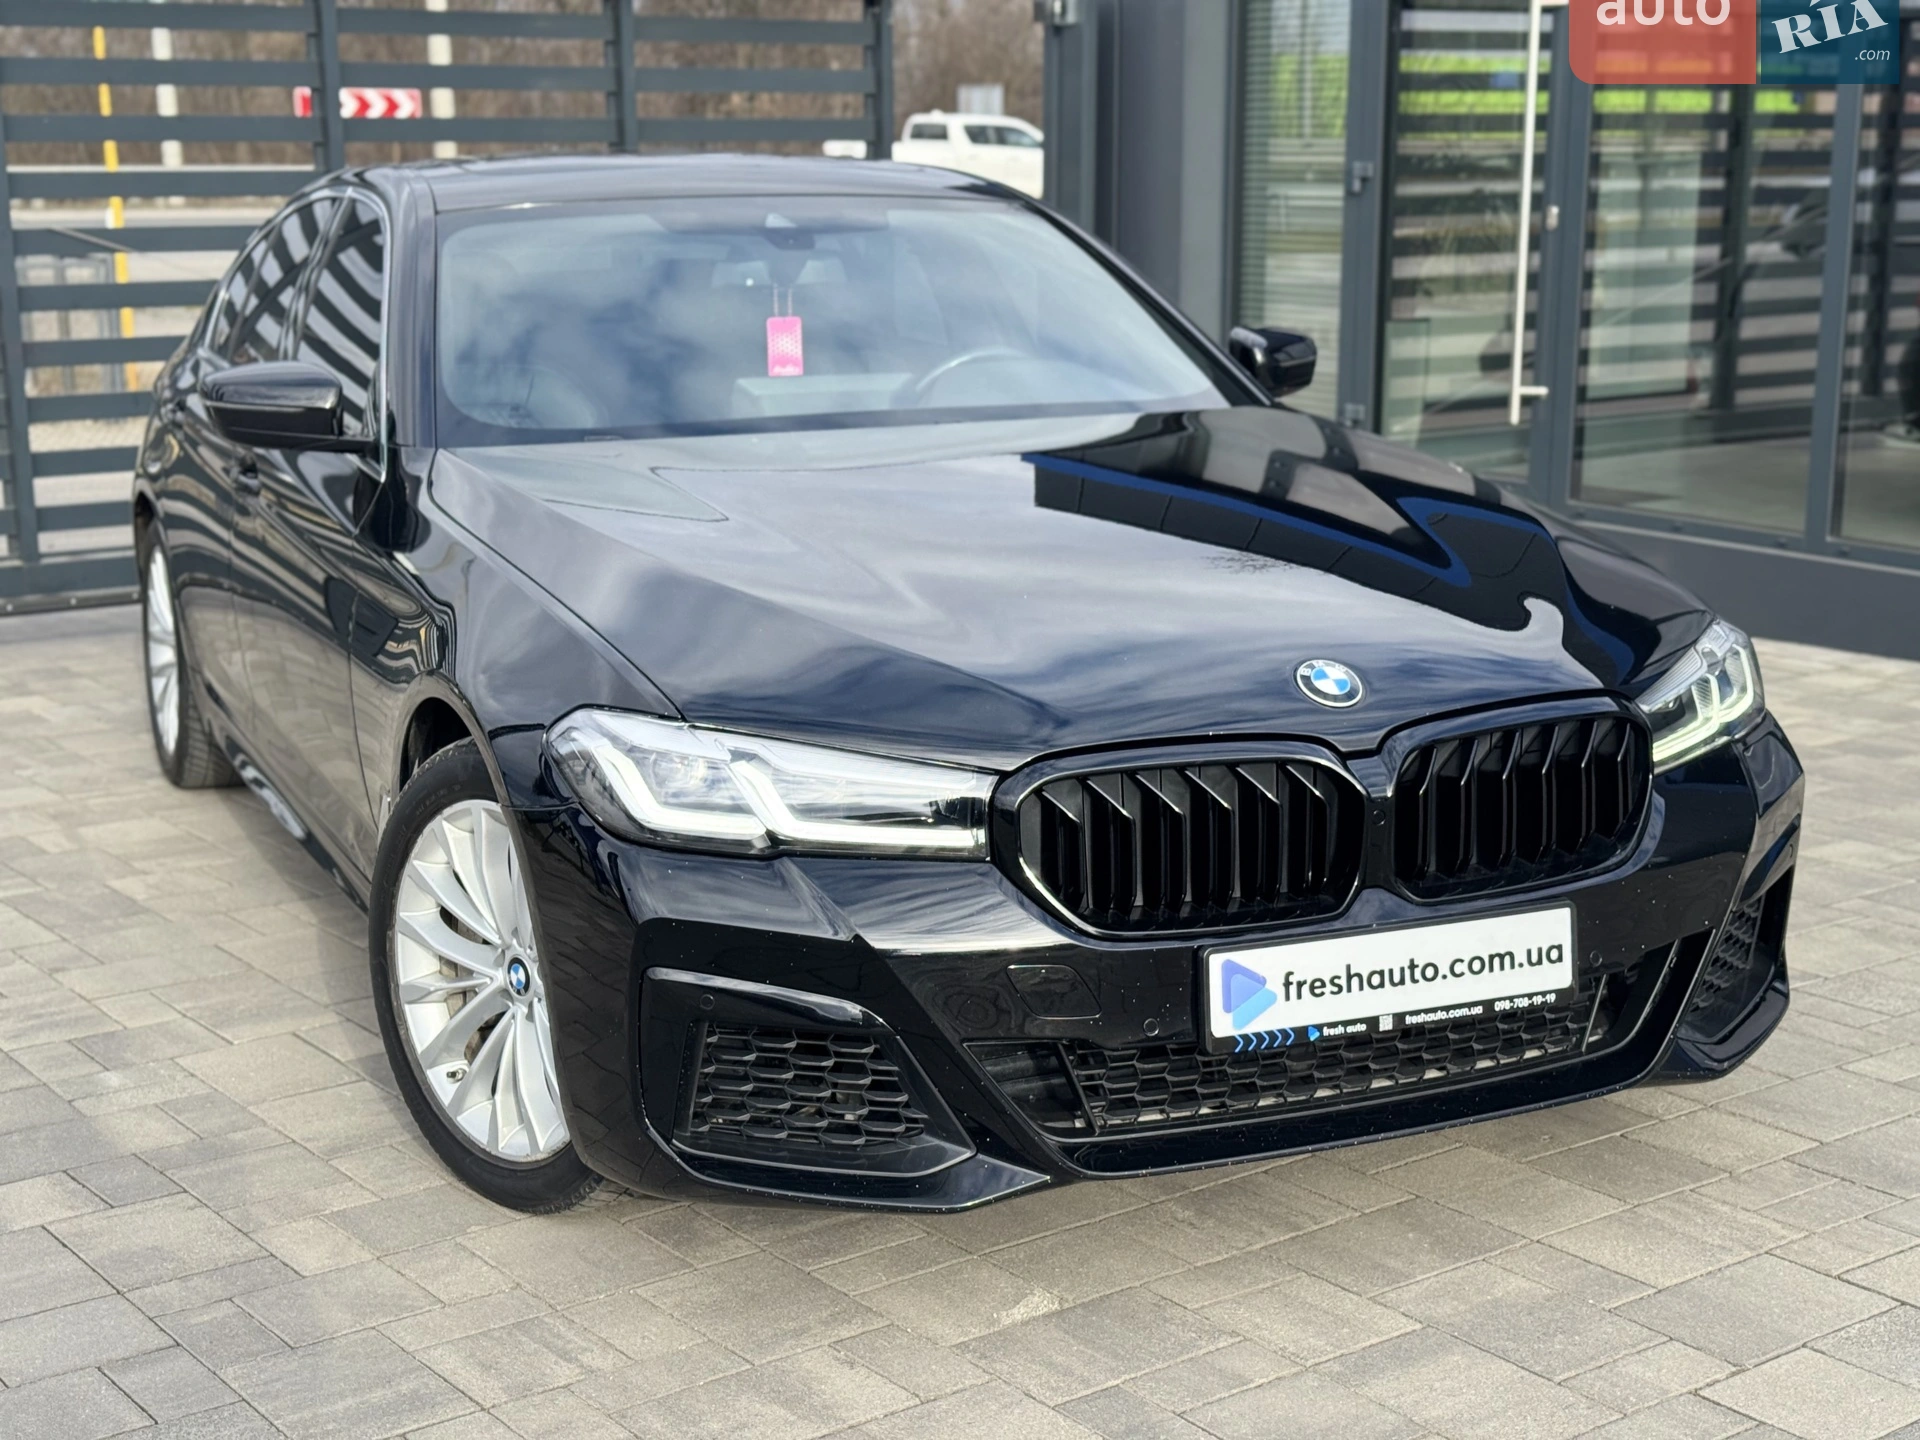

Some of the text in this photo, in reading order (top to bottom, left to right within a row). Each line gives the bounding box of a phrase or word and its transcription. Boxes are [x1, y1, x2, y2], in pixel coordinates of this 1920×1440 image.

[1283, 943, 1564, 1002] freshauto.com.ua
[1322, 1024, 1345, 1036] fresh
[1346, 1023, 1367, 1034] auto
[1405, 1005, 1483, 1025] freshauto.com.ua
